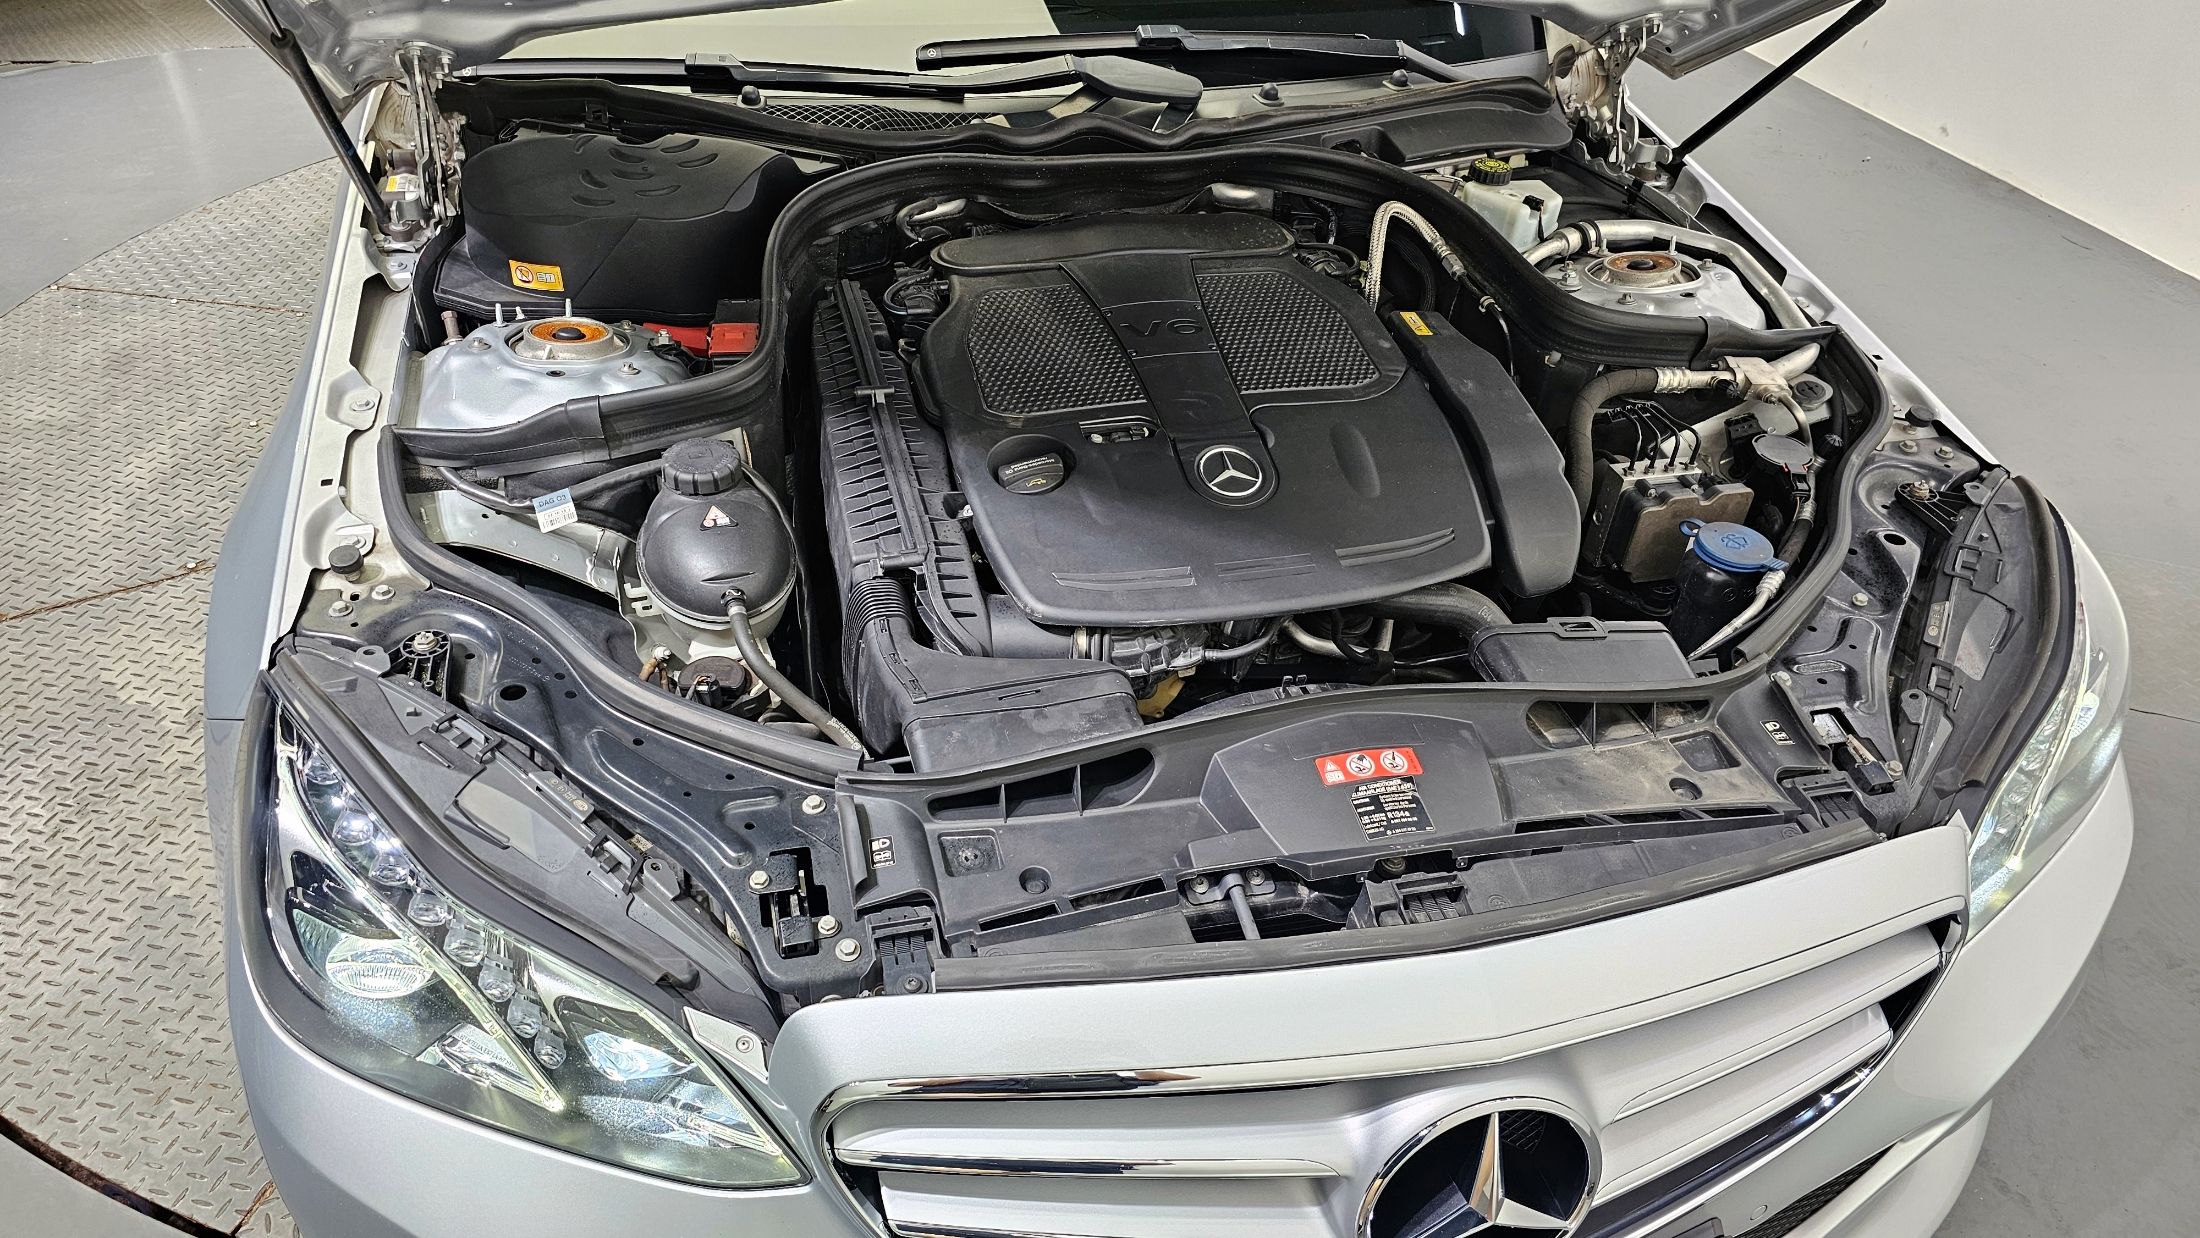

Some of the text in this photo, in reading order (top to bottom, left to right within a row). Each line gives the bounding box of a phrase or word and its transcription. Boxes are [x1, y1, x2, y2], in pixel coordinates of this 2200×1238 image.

[1119, 319, 1203, 337] V6
[539, 498, 555, 507] DAG
[1387, 811, 1411, 819] R134a
